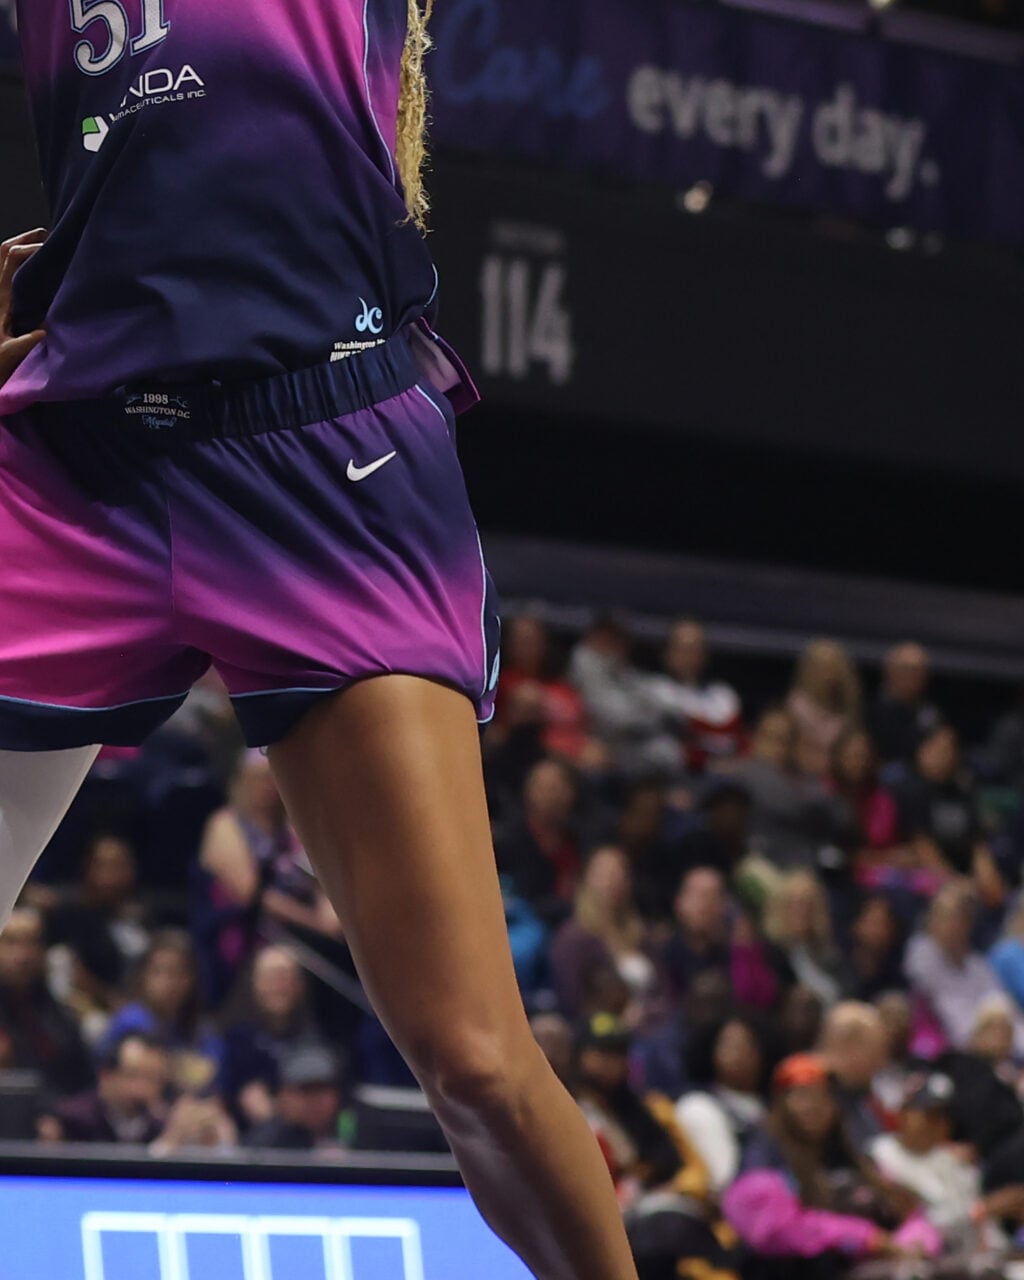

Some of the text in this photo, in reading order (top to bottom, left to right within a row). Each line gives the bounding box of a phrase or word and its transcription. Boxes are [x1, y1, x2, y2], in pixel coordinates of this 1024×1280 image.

[625, 62, 805, 180] every
[812, 81, 941, 202] day.
[482, 255, 573, 384] 114
[124, 406, 177, 416] WASHINGTON
[143, 393, 169, 404] 1998
